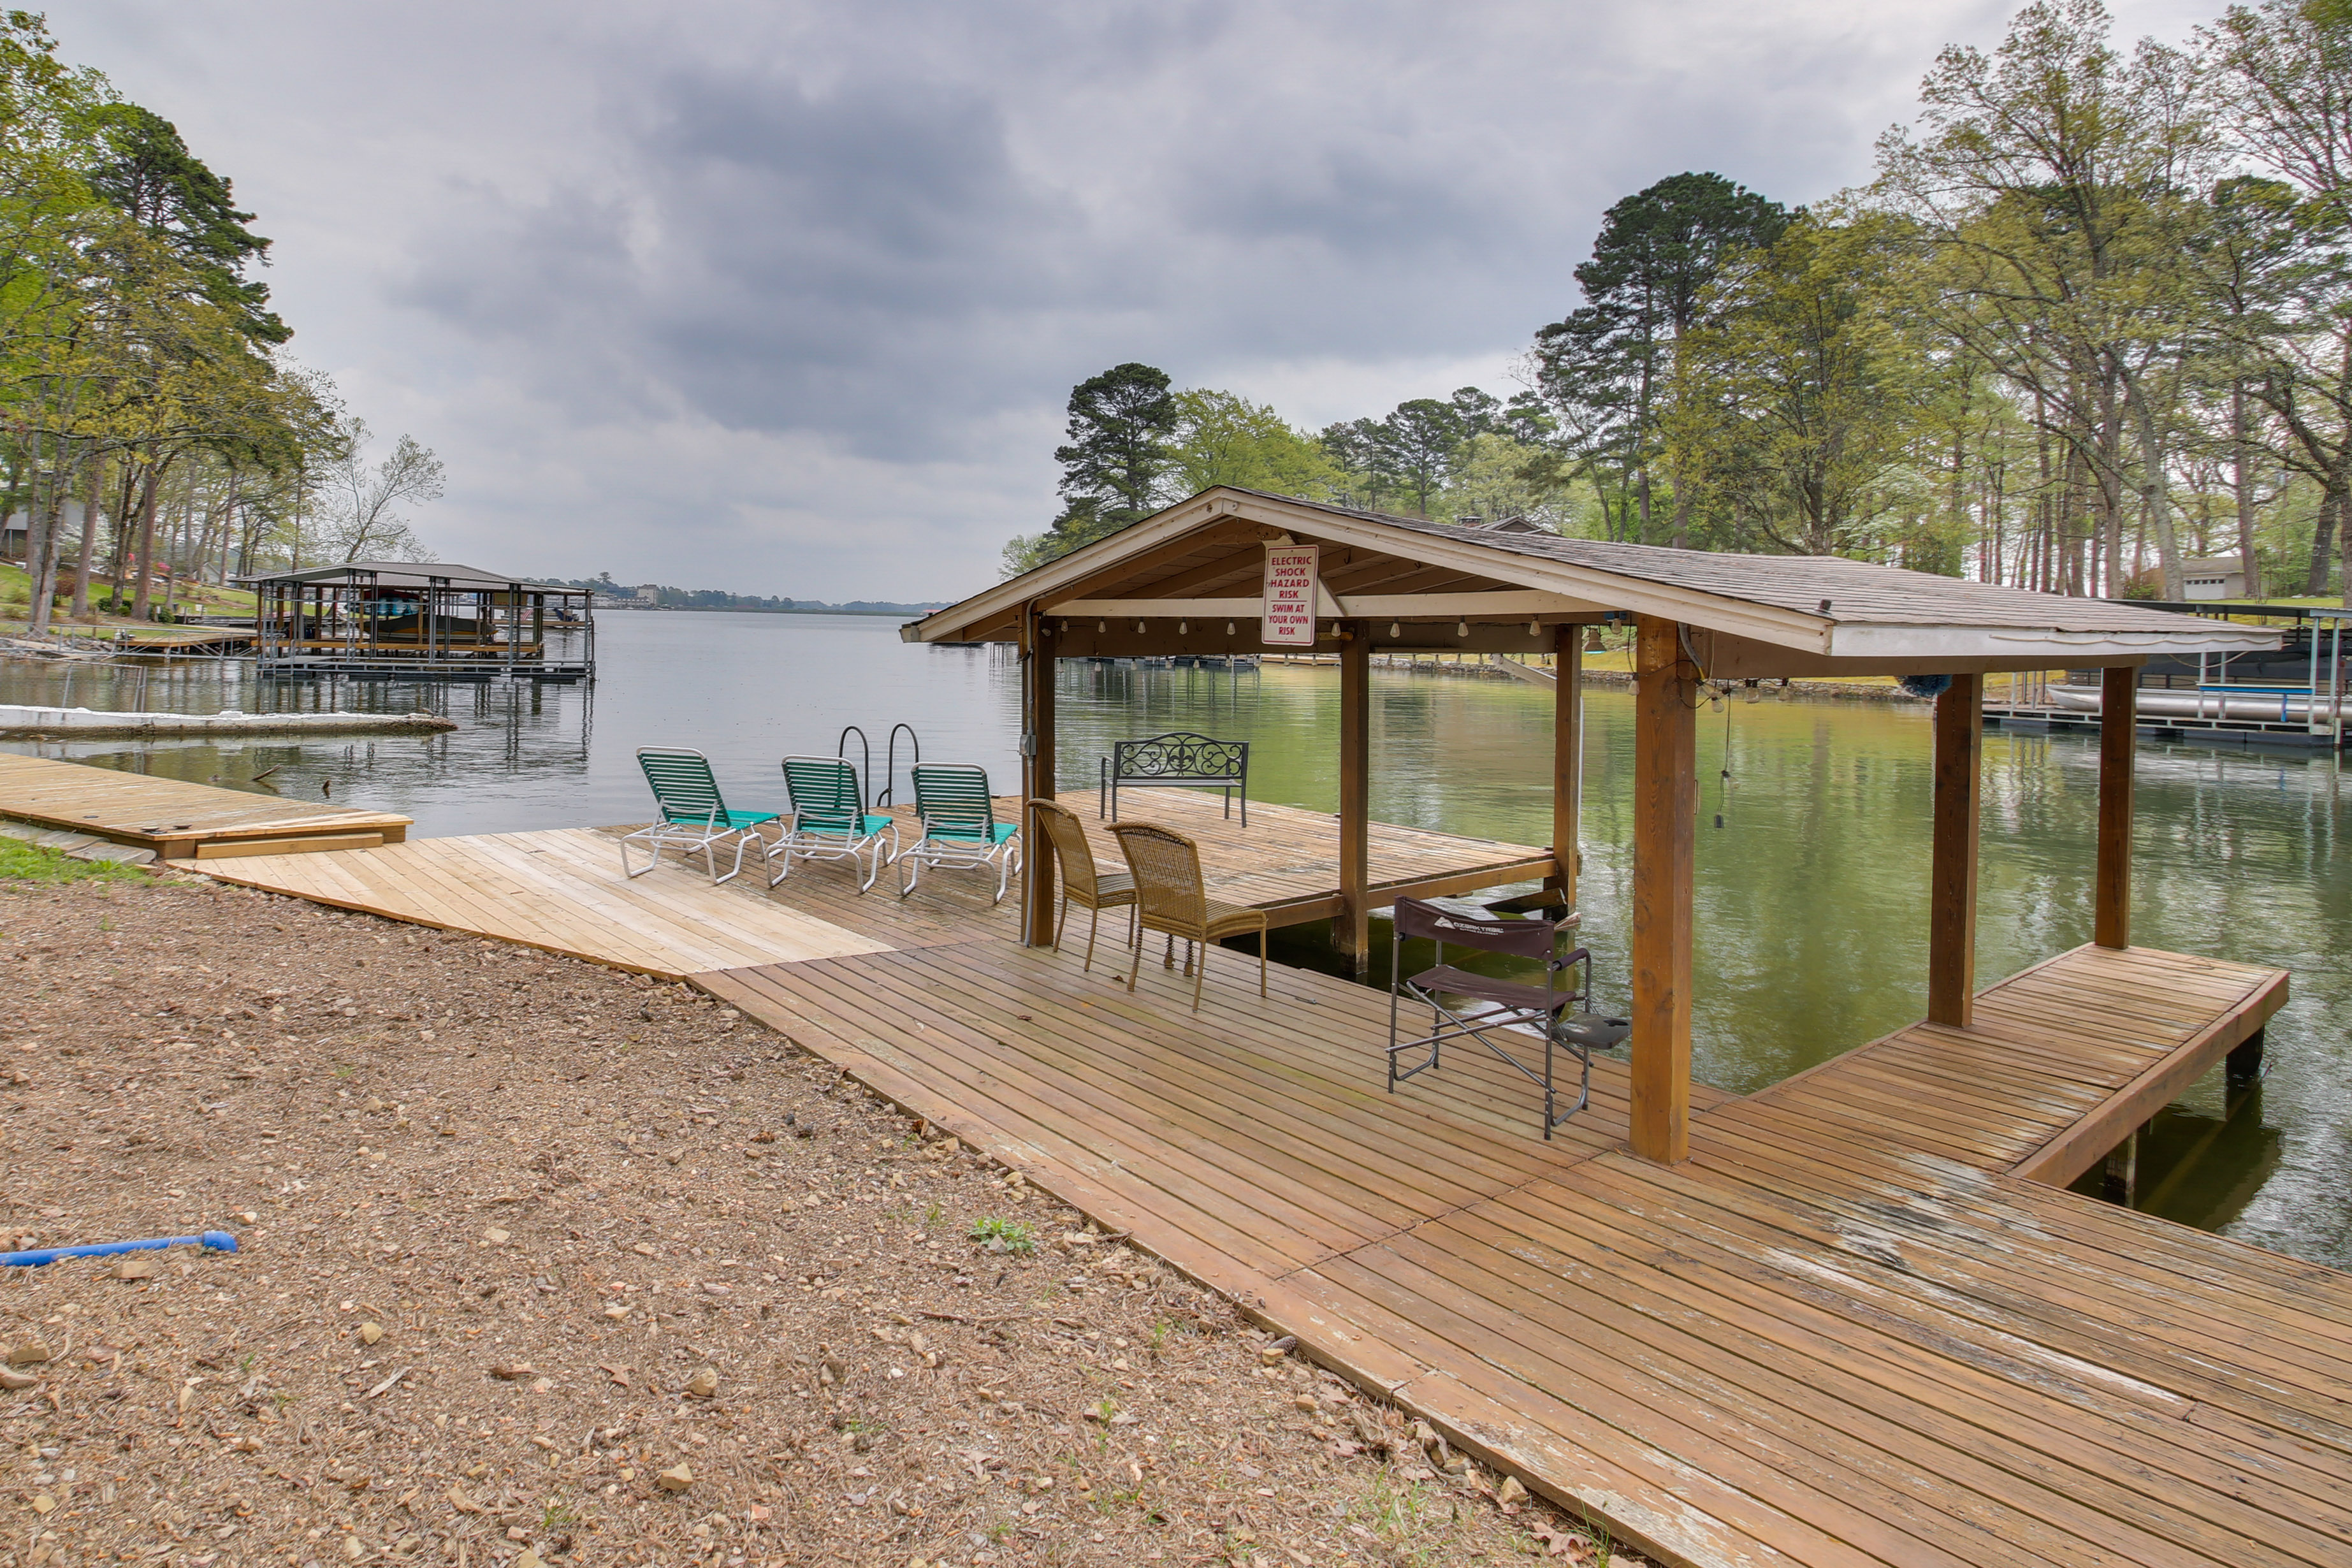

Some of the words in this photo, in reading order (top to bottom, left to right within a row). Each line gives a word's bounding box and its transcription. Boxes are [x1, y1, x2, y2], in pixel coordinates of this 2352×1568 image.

[1272, 556, 1312, 565] ELECTRIC
[1275, 568, 1306, 577] SHOCK
[1270, 579, 1309, 588] HAZARD
[1279, 590, 1298, 599] RISK
[1272, 604, 1293, 613] SWIM
[1279, 627, 1295, 635] RISK
